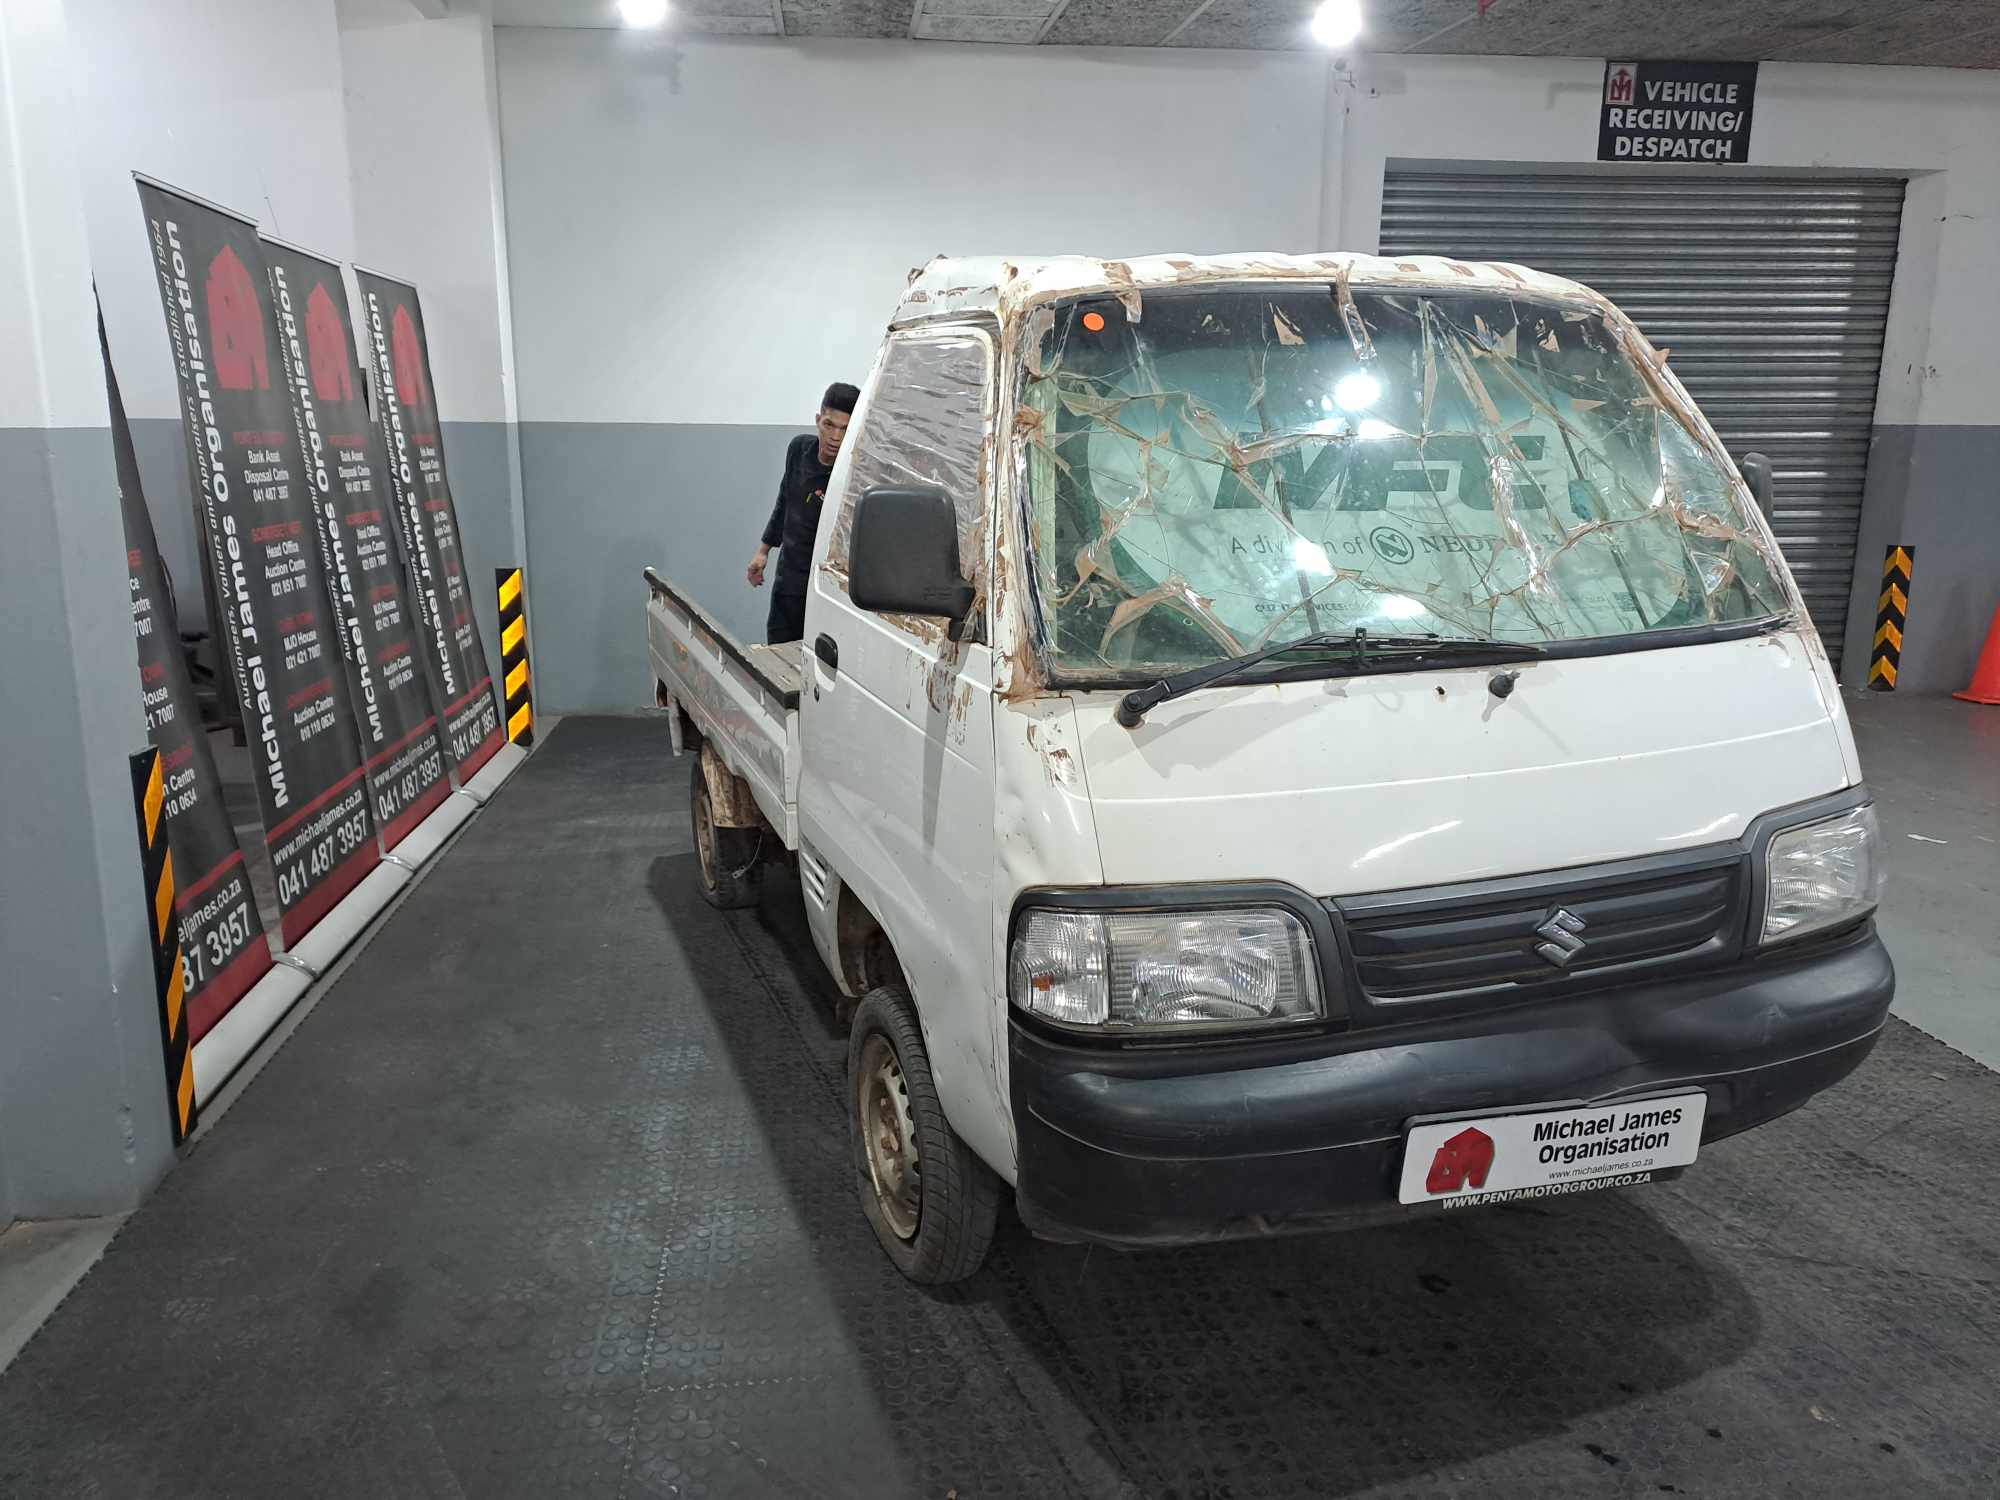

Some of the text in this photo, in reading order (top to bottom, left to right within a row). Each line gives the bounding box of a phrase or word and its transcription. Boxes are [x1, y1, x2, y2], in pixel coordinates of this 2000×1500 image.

[1645, 81, 1739, 104] VEHICLE
[1609, 108, 1744, 132] RECEIVING/
[1614, 136, 1732, 160] DESPATCH
[162, 271, 189, 378] Established
[275, 266, 329, 492] Organisation
[369, 292, 411, 484] Organisation
[187, 395, 211, 489] Appraisers
[248, 450, 264, 464] Bank
[244, 468, 272, 486] Disposal
[253, 488, 264, 502] 041
[166, 220, 289, 808] Michael James Organisation
[205, 495, 217, 529] and
[308, 485, 320, 514] and
[325, 502, 355, 608] James
[407, 491, 432, 581] James
[1231, 535, 1364, 555] A divn of
[214, 534, 231, 598] Valuers
[265, 563, 288, 579] Auction
[228, 605, 252, 709] Auctioneers,
[425, 589, 456, 695] Michael
[347, 617, 384, 742] Michael
[156, 703, 175, 726] 7007
[452, 732, 470, 761] 041
[469, 719, 481, 747] 487
[169, 766, 195, 791] Centre
[379, 751, 441, 820] 041 487 3957
[179, 788, 198, 812] 0634
[273, 789, 362, 866] www.michaeljames.co.za
[279, 808, 367, 905] 041 487 3957
[181, 902, 251, 993] 87 3957
[1533, 1107, 1682, 1142] Michael James
[1538, 1129, 1669, 1165] Organisation
[1548, 1157, 1654, 1180] www.michaeljames.co.za
[1442, 1172, 1651, 1210] WWW.PENTAMOTORGROUP.CO.ZA
